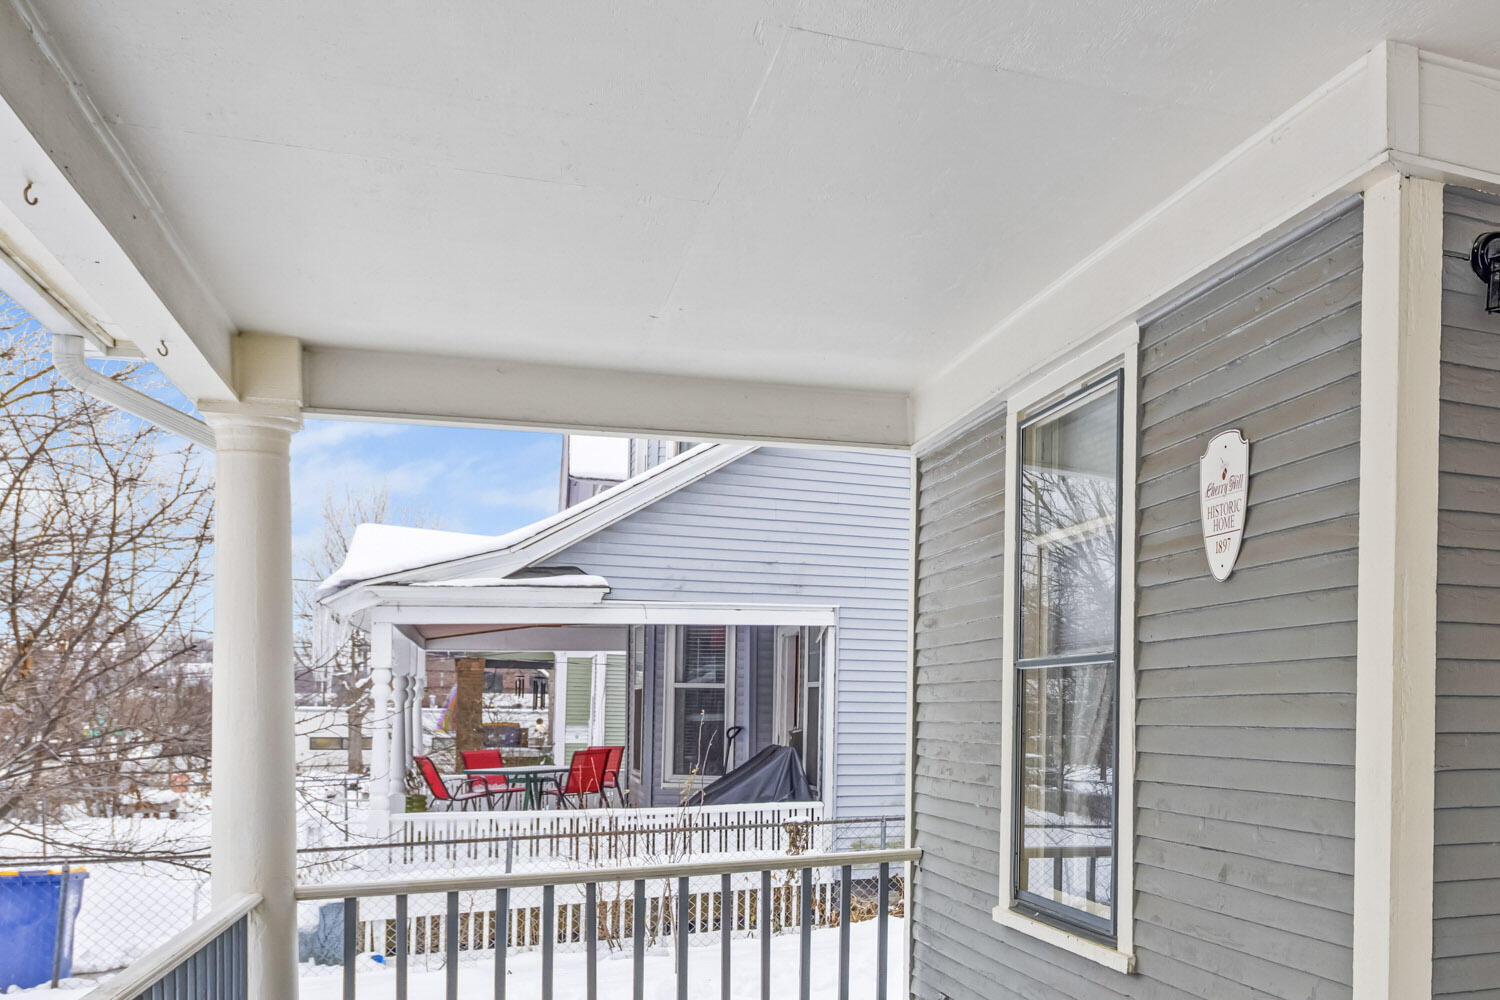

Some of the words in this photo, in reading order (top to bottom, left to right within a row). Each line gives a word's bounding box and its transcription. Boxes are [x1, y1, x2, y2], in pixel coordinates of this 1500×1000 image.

[1206, 481, 1229, 498] Cherry
[1229, 474, 1244, 492] Hill
[1207, 498, 1242, 520] HISTORIC
[1213, 515, 1236, 532] HOME
[1215, 537, 1231, 554] 1897
